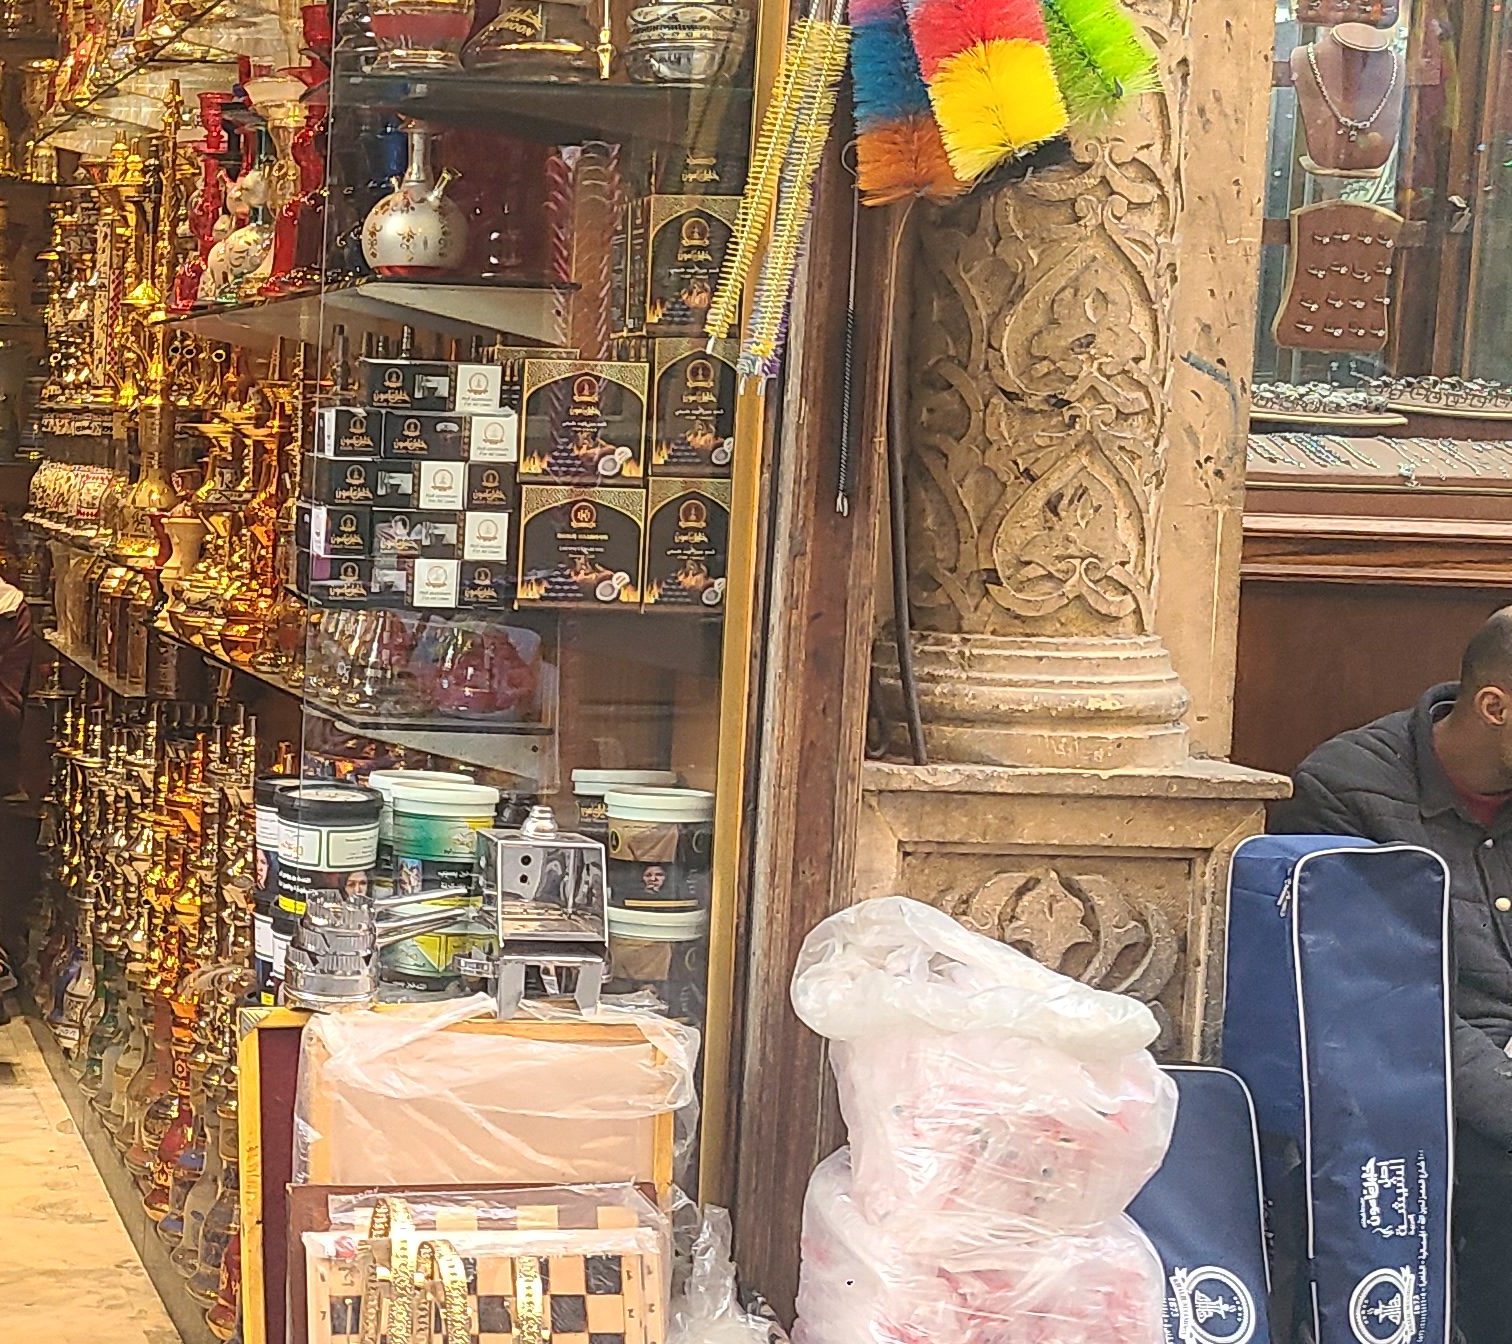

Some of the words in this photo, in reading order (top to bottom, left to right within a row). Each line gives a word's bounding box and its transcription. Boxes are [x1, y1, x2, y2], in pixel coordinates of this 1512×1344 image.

[1360, 1156, 1379, 1198] خليل
[1388, 1158, 1408, 1236] الشيشة
[1363, 1186, 1380, 1227] مأمون
[1168, 1297, 1179, 1319] 1873
